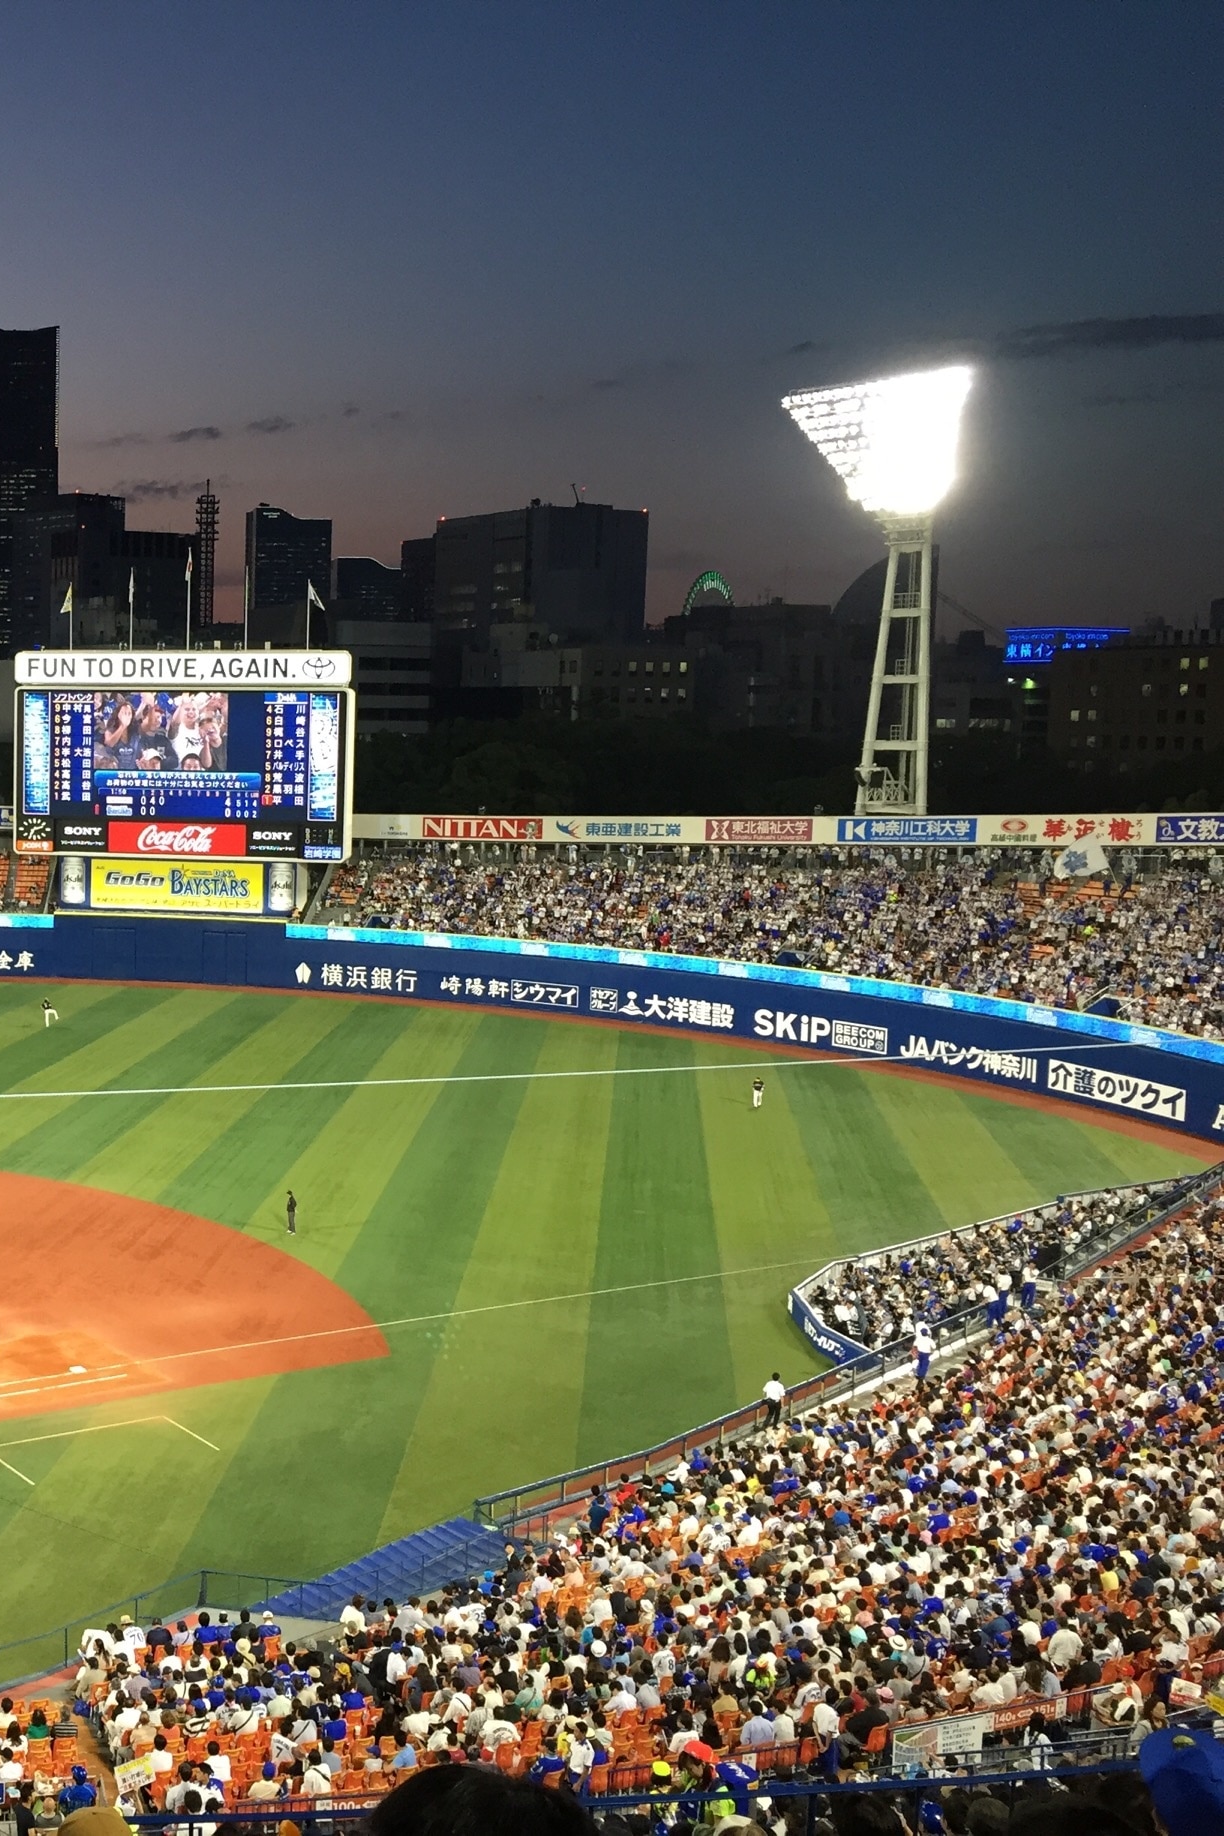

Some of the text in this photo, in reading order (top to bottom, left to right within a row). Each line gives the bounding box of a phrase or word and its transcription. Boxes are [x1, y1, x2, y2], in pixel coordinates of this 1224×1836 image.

[27, 658, 296, 681] FUN TO DRIVE, AGAIN.
[55, 703, 61, 713] 9
[266, 704, 272, 714] 4
[55, 714, 61, 724] 6
[266, 716, 272, 725] 6
[55, 725, 61, 734] 8
[266, 727, 272, 737] 9
[55, 736, 61, 745] 7
[265, 739, 272, 748] 3
[55, 747, 61, 757] 3
[265, 750, 272, 760] 7
[55, 758, 61, 768] 5
[265, 761, 271, 771] 5
[54, 769, 60, 779] 4
[265, 772, 271, 782] 8
[54, 780, 60, 790] 2
[264, 784, 271, 794] 2
[54, 791, 59, 801] 1
[264, 796, 270, 805] 1
[64, 826, 102, 836] SONY
[425, 818, 519, 838] NITTAN
[585, 823, 681, 837] 東亜建設工業
[731, 820, 809, 835] 東北福祉大学
[870, 820, 971, 836] 神奈川工科大学
[1177, 818, 1224, 841] 文教
[137, 824, 217, 853] Coca-Cola
[252, 831, 293, 841] SONY
[320, 963, 419, 993] 横浜銀行
[644, 993, 735, 1030] 大洋建設
[836, 1023, 885, 1041] BEECOM
[835, 1034, 875, 1049] GROUP
[900, 1034, 1038, 1084] JAバンク神奈川
[1050, 1062, 1185, 1118] 介護のツクイ
[276, 1746, 283, 1758] 7
